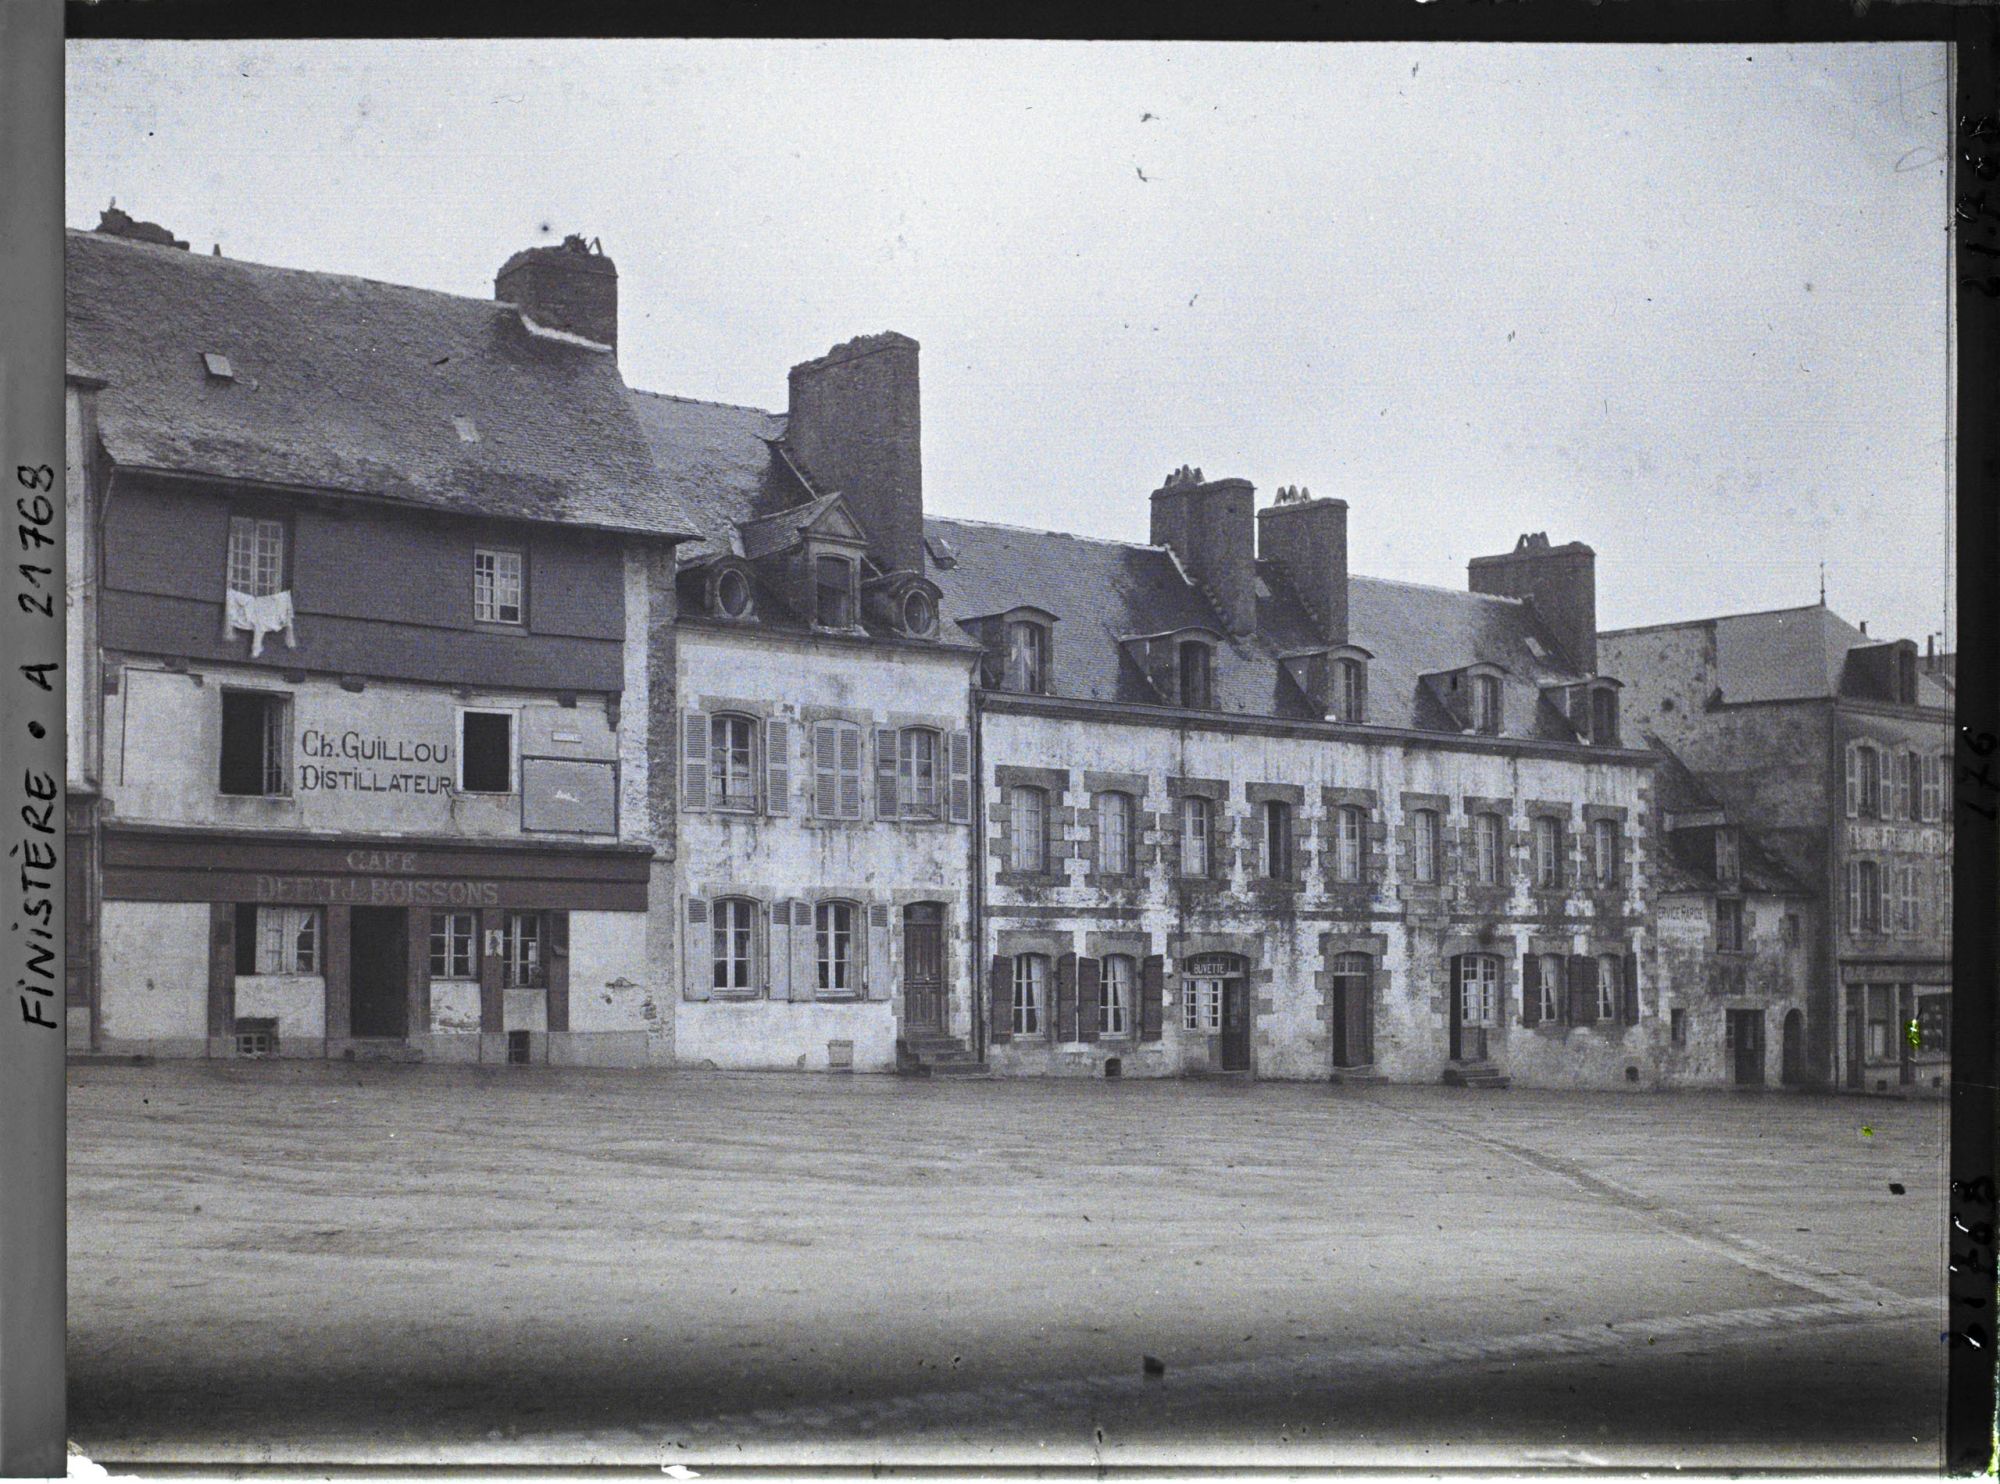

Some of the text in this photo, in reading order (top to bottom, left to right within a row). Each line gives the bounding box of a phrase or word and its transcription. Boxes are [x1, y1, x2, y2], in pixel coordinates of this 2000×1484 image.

[19, 662, 59, 692] A
[301, 729, 340, 758] Ch.
[371, 878, 499, 905] BOISSONS
[1193, 963, 1225, 975] BUVETTE
